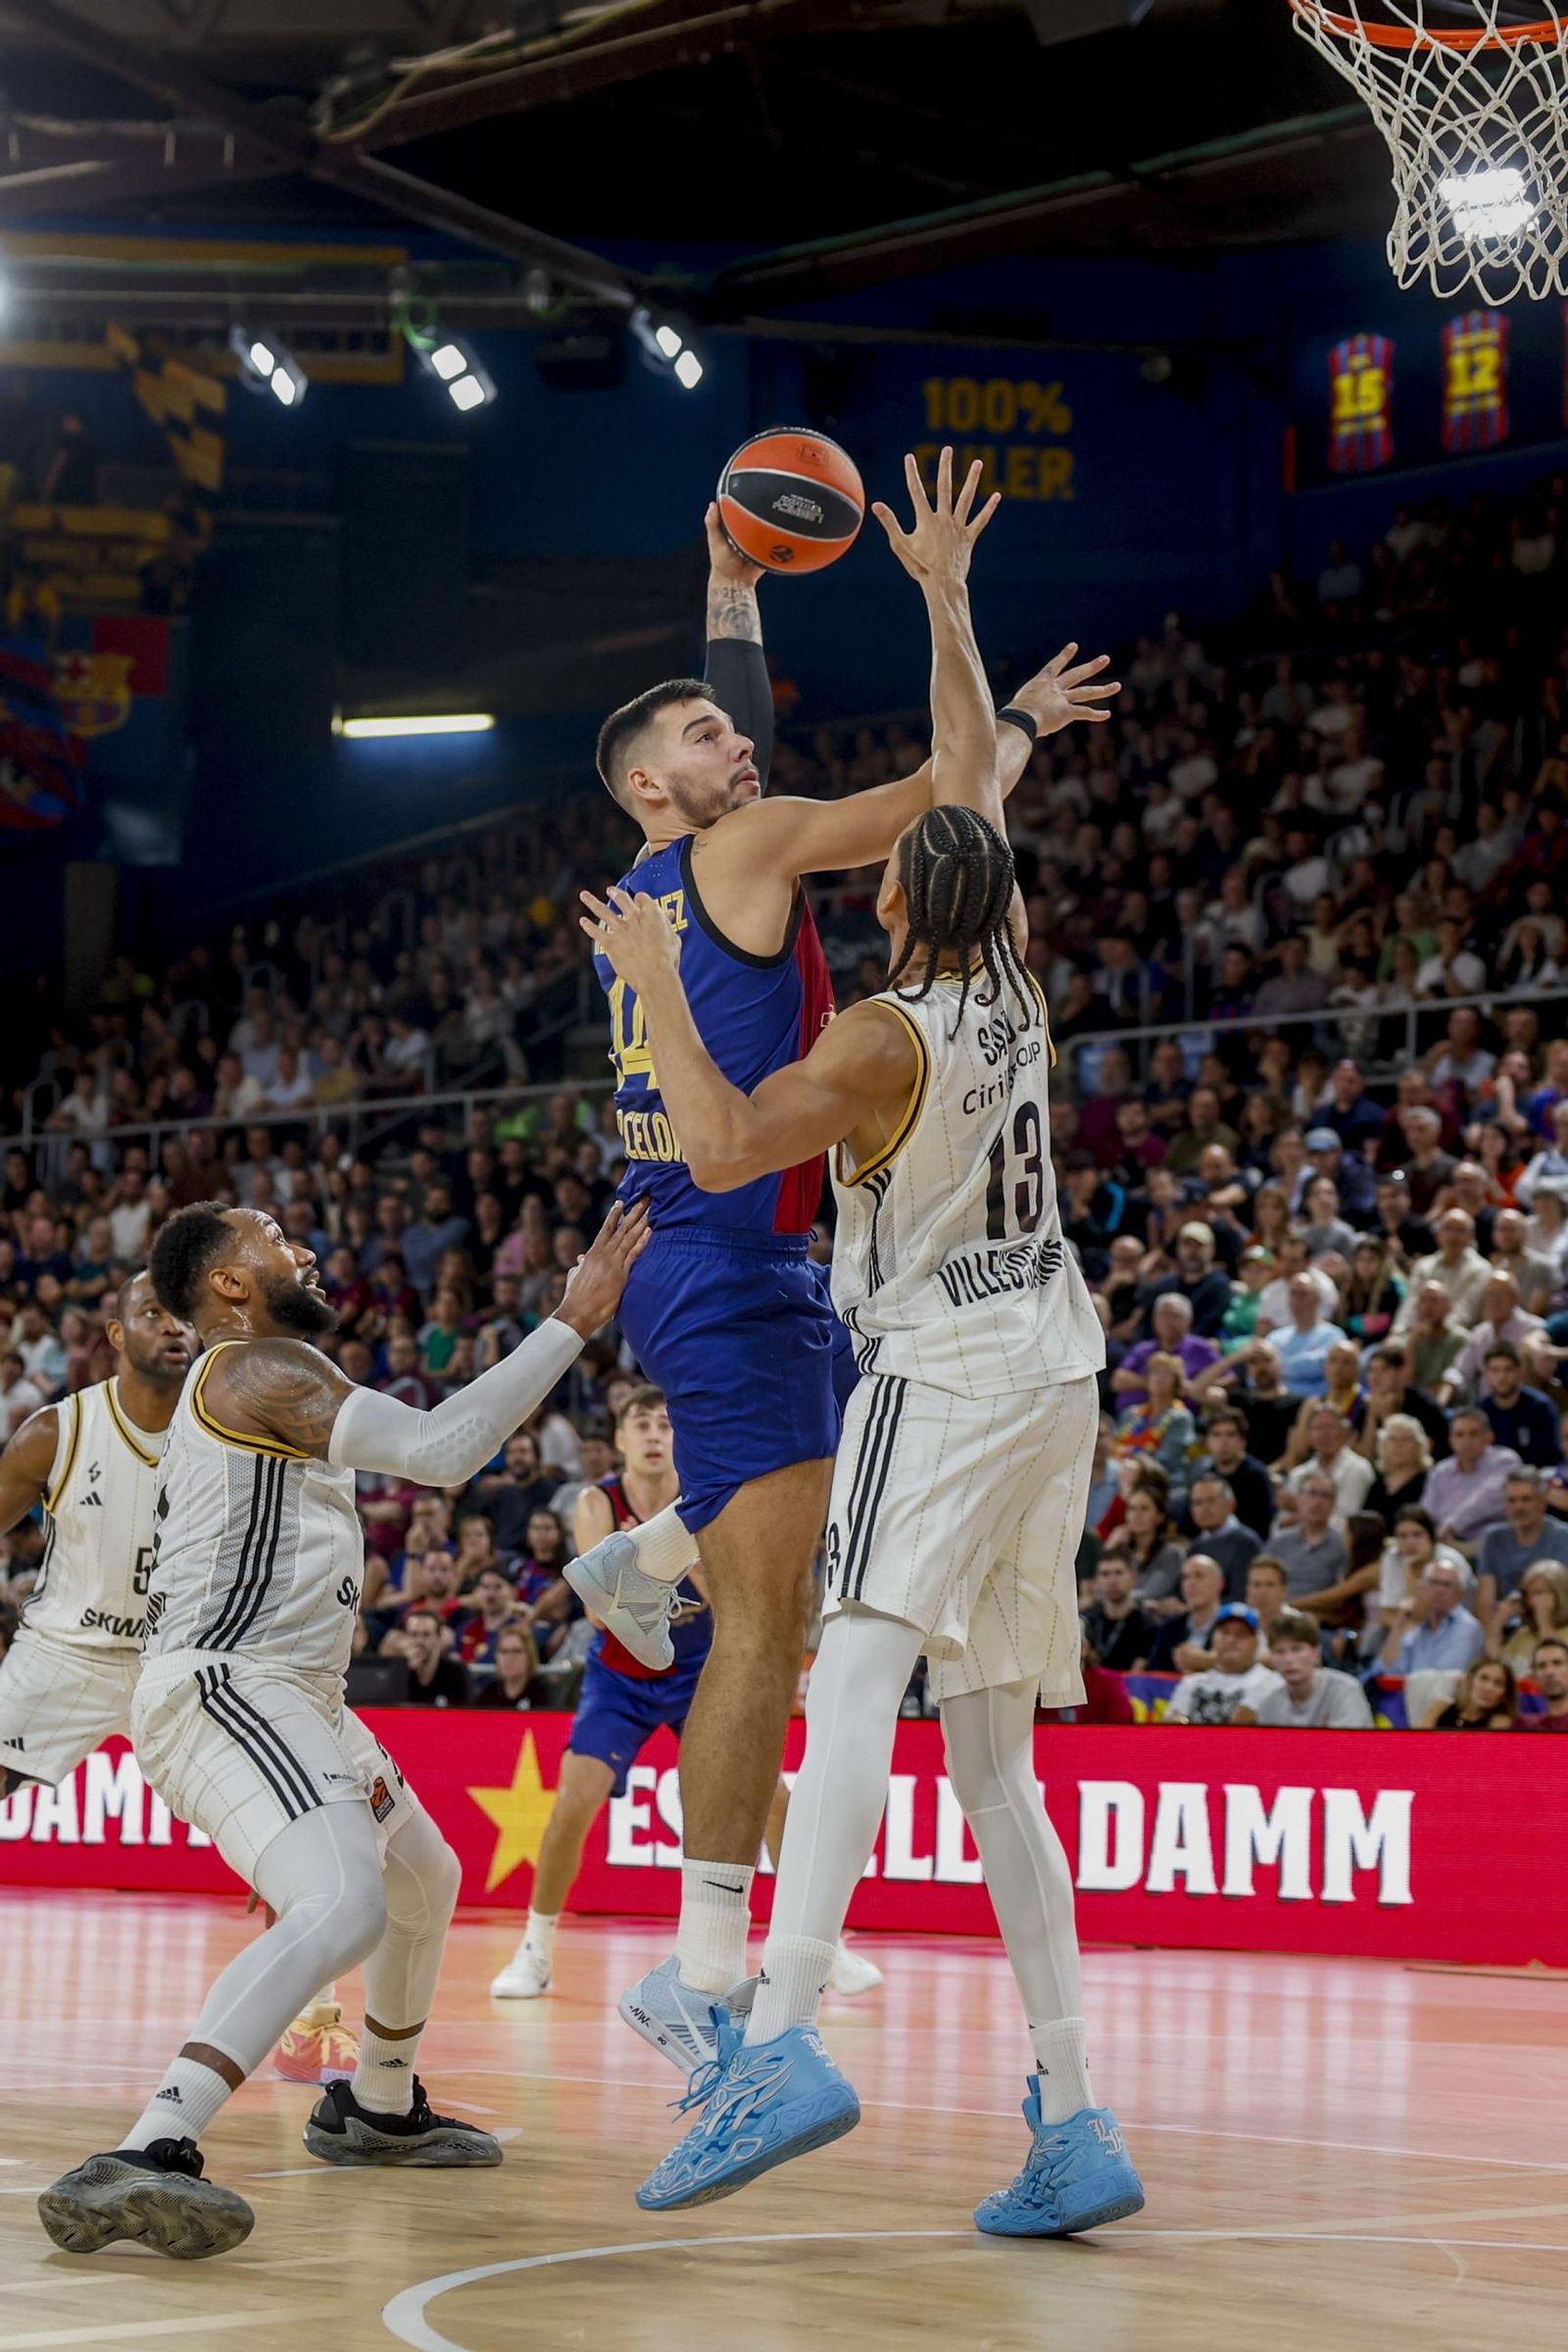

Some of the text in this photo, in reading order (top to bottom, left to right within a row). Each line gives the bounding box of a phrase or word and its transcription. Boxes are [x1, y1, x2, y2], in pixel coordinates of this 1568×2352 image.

[1333, 368, 1387, 420] 15
[1447, 347, 1500, 397] 12
[923, 376, 1073, 435] 100%
[987, 1101, 1043, 1240] 13
[1075, 1780, 1416, 1905] DAMM
